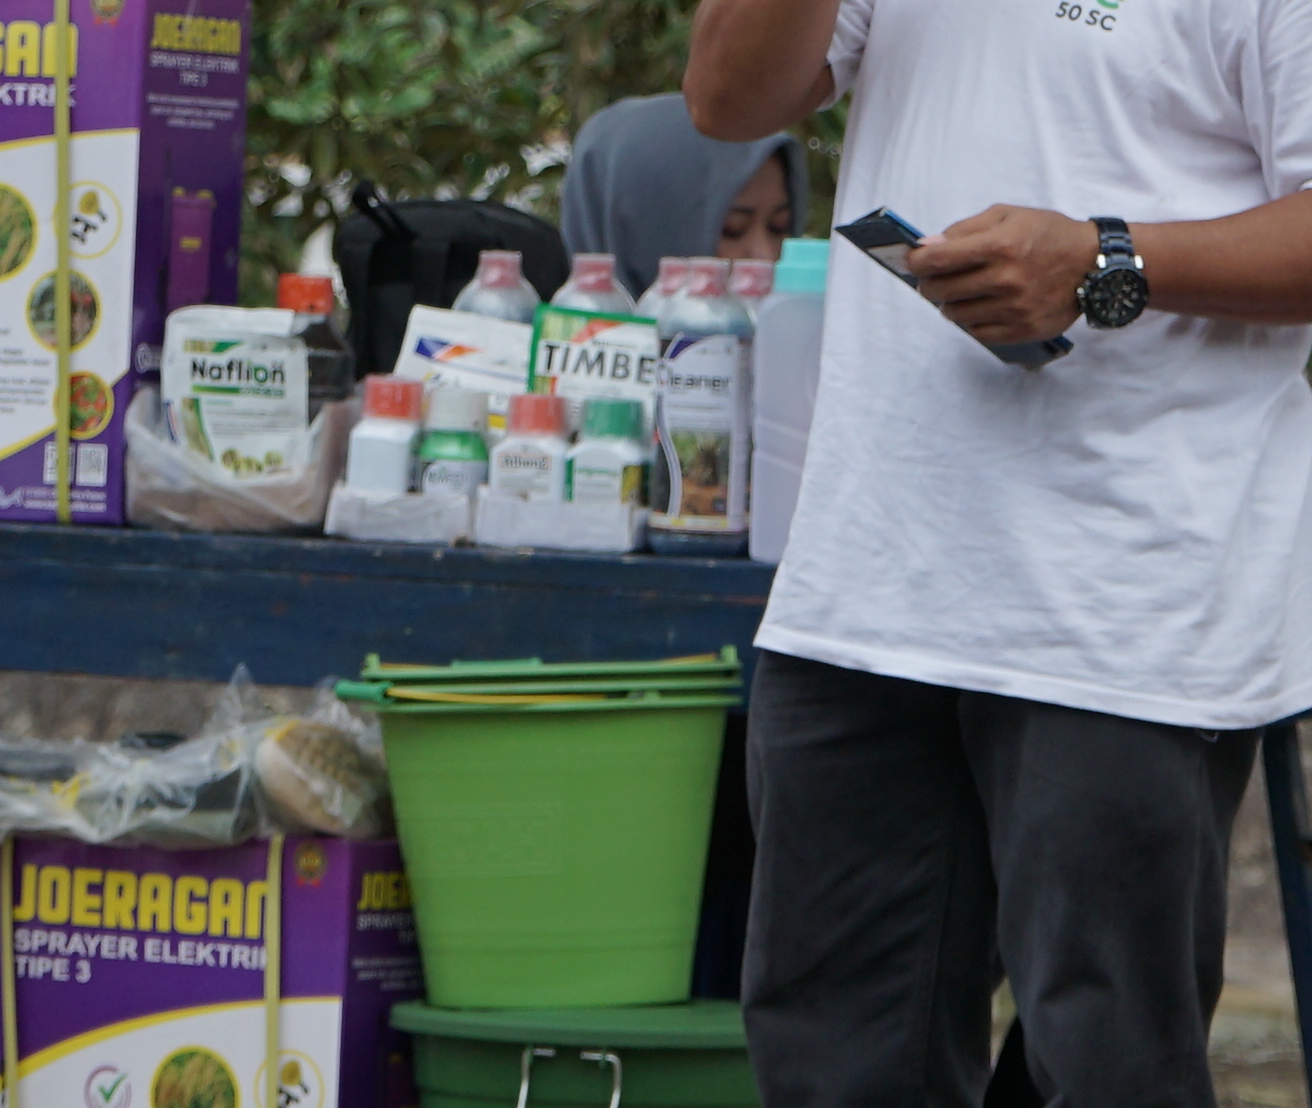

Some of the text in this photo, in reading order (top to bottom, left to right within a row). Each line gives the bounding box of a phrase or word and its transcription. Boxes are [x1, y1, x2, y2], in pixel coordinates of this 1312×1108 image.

[1055, 2, 1117, 31] 50 SC
[15, 928, 138, 961] SPRAYER
[15, 955, 91, 984] TIPE 3
